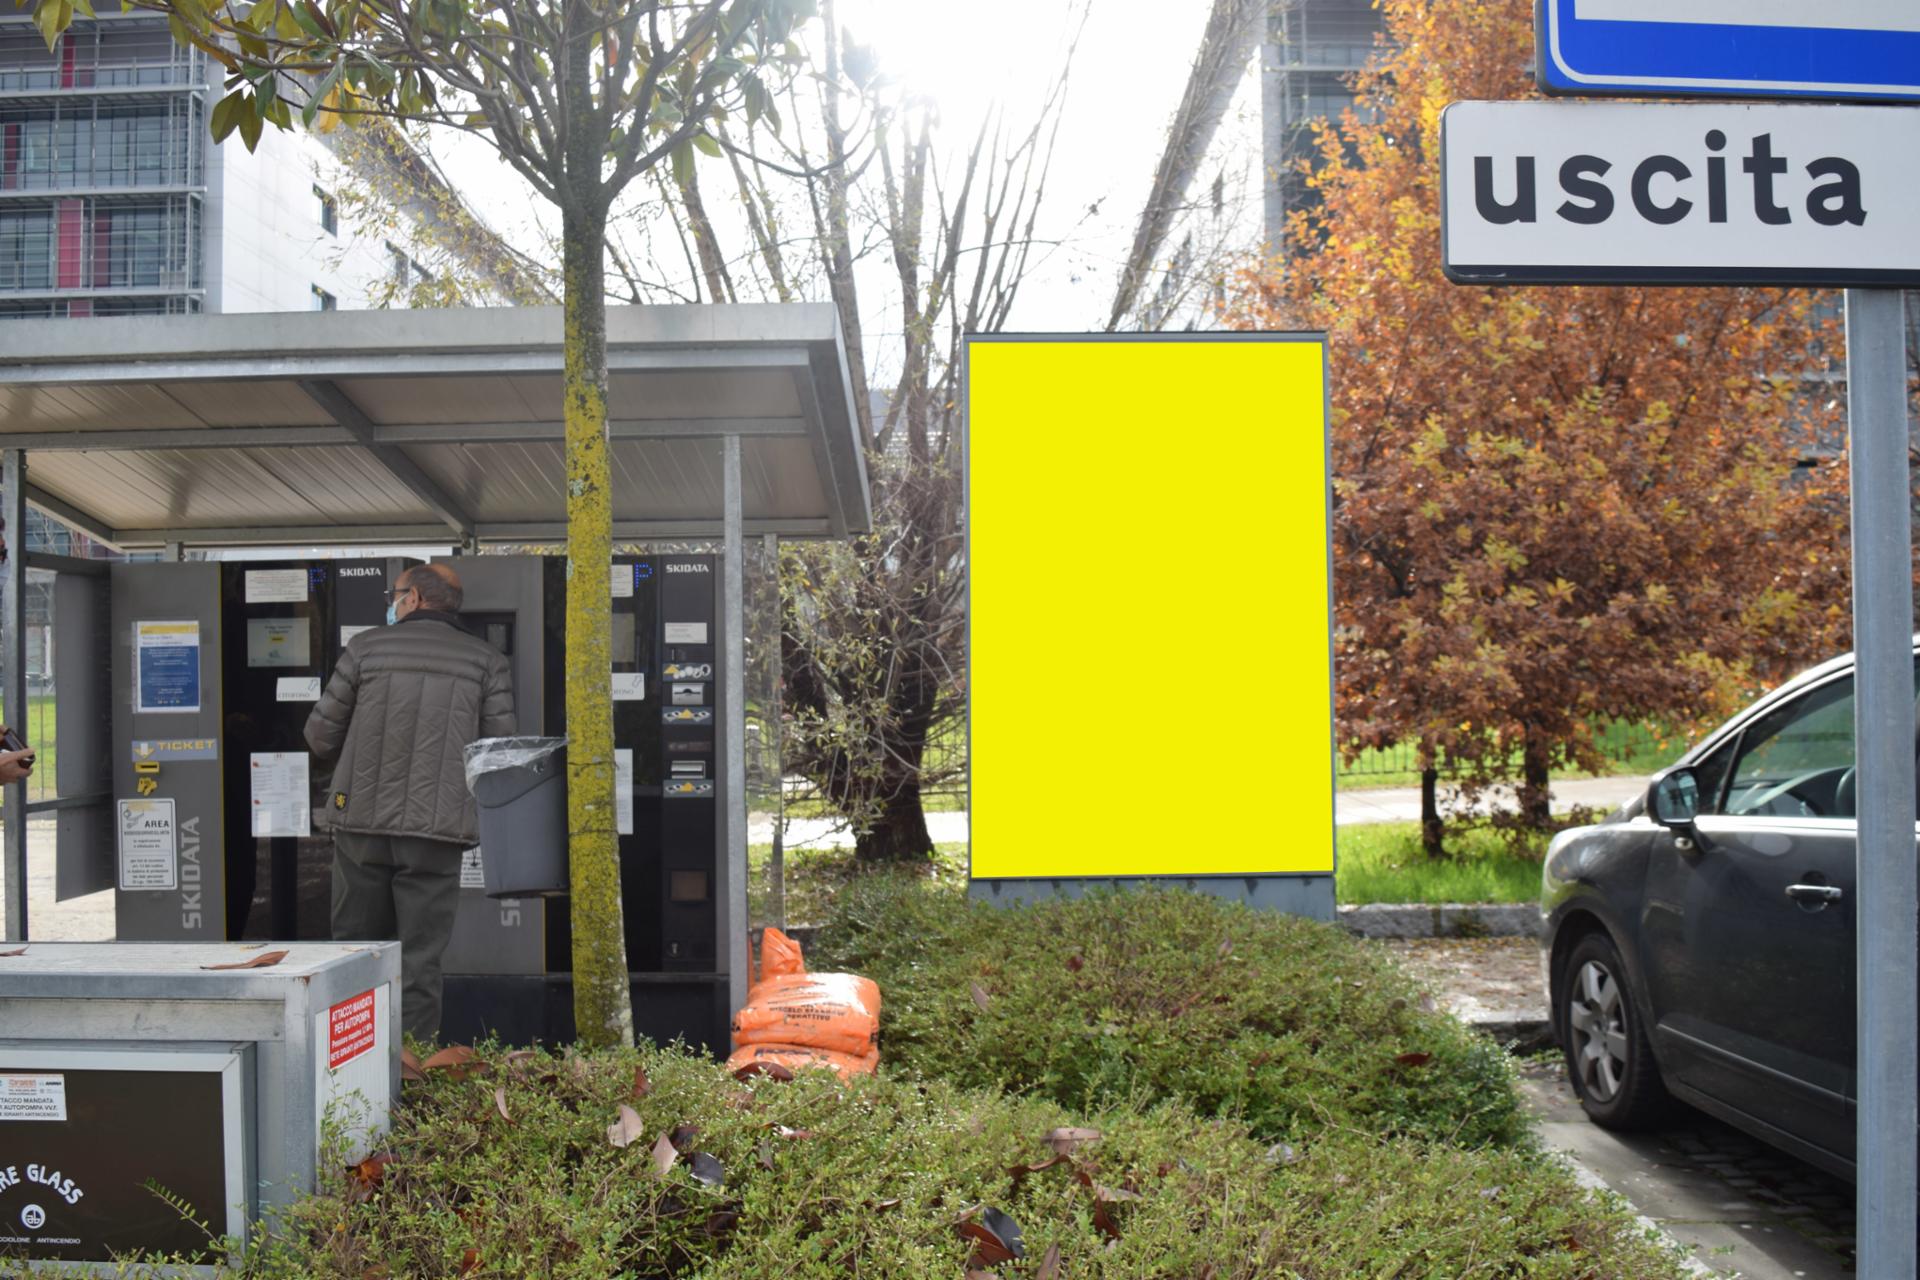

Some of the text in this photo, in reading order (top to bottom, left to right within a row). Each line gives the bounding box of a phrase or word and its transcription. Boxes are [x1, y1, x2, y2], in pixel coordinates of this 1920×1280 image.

[1474, 129, 1867, 226] uscita
[339, 567, 382, 577] SKIDATA
[665, 564, 709, 573] SKIDATA
[157, 739, 215, 751] TICKET
[144, 820, 170, 828] AREA
[181, 816, 202, 929] SKIDATA
[26, 1163, 84, 1205] GLASS
